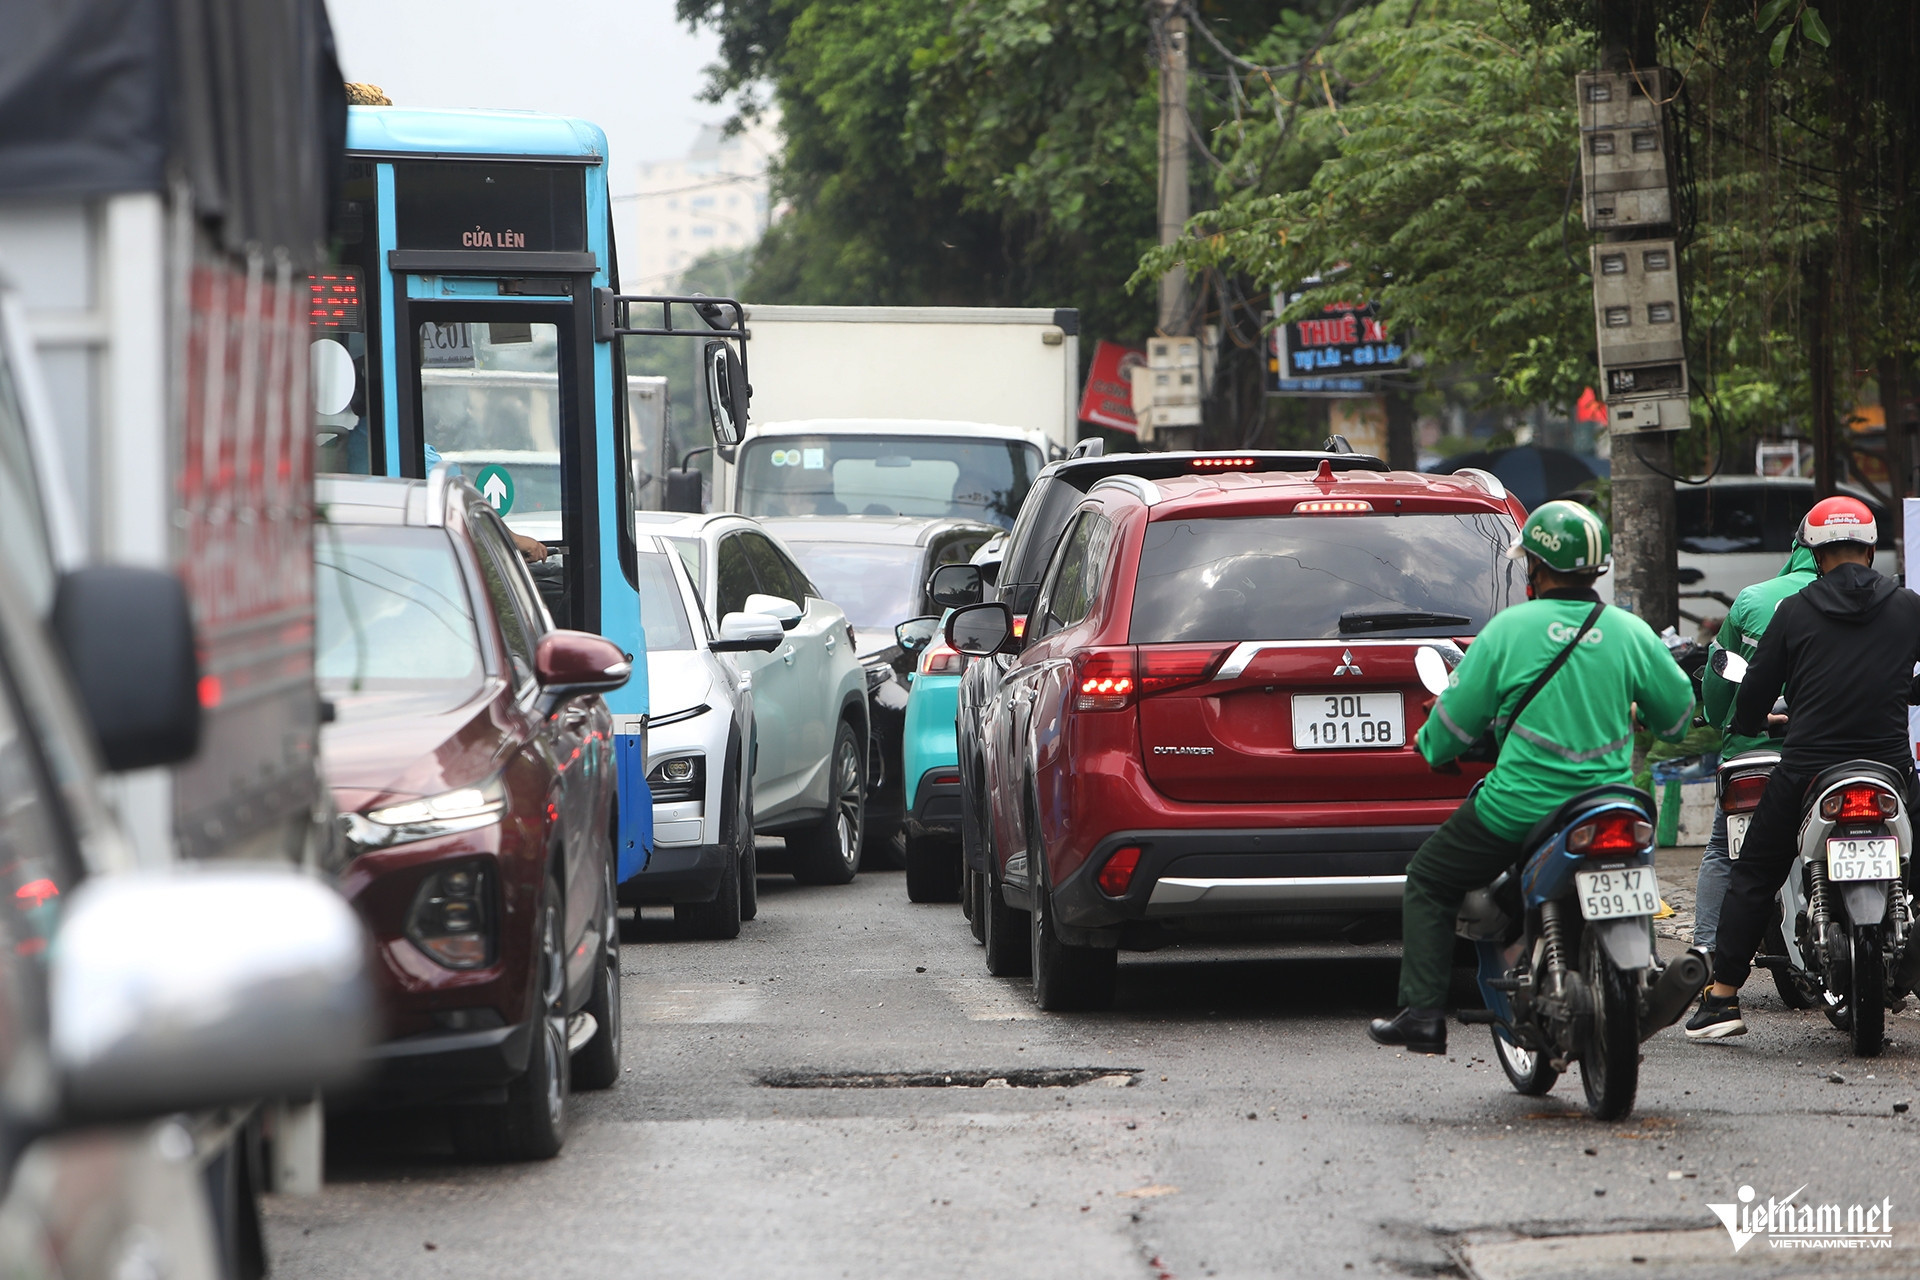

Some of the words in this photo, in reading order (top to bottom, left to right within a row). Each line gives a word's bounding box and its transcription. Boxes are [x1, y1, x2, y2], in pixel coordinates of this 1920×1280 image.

[462, 225, 493, 247] CỬA
[497, 229, 525, 248] LÊN
[1297, 312, 1358, 347] THUÊ
[1361, 316, 1388, 343] X
[1531, 525, 1561, 552] Grab
[1325, 696, 1371, 718] 30L
[1310, 721, 1391, 744] 101.08
[1153, 746, 1214, 755] OUTLANDER
[1838, 841, 1886, 859] 29-S2
[1833, 860, 1893, 879] 057.51
[1589, 871, 1641, 894] 29-X7
[1587, 892, 1655, 916] 599.18
